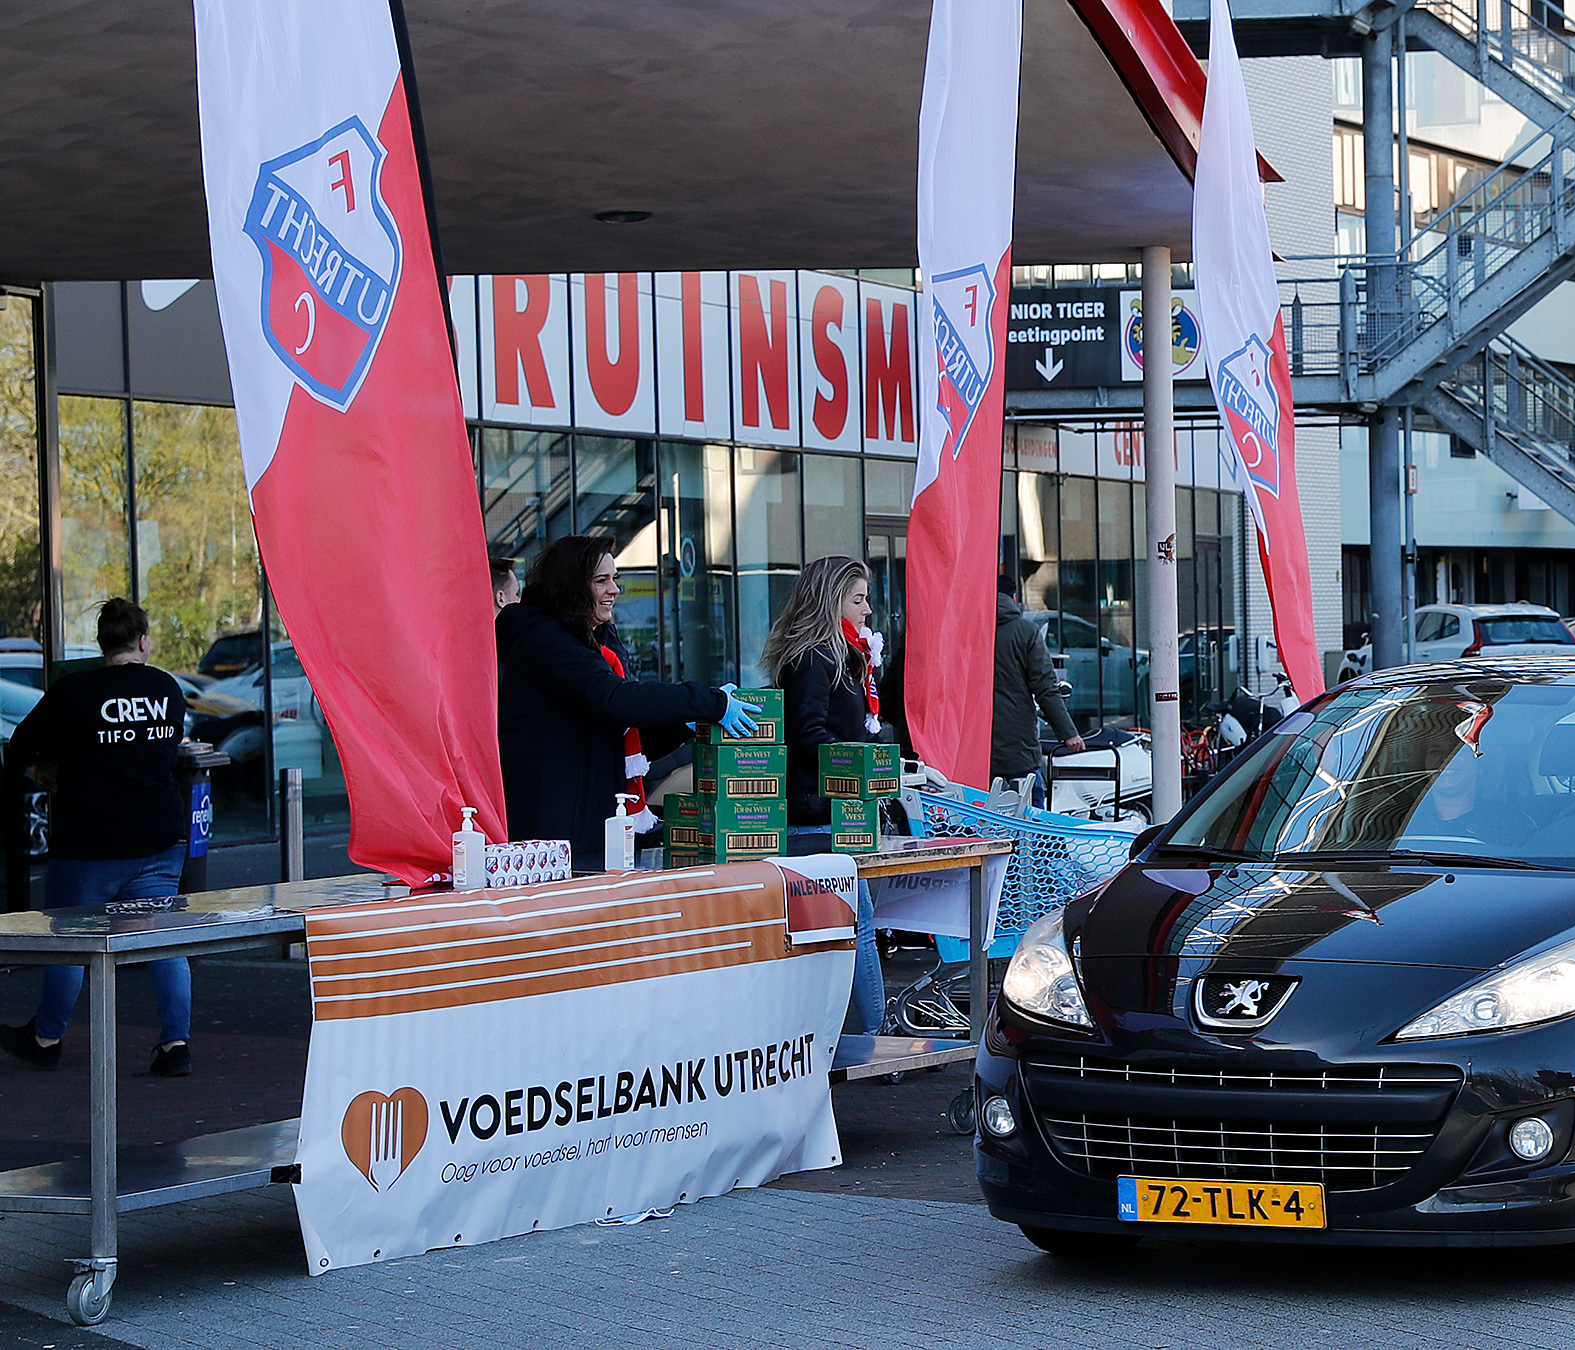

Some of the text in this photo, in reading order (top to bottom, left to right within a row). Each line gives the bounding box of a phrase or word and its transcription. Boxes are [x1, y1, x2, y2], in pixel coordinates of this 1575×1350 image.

[1010, 301, 1106, 320] NIOR TIGER
[1008, 325, 1105, 346] eetingpoint
[447, 271, 915, 442] RUINSM
[100, 696, 169, 723] CREW
[97, 726, 175, 744] TIFO ZUID
[789, 876, 855, 898] INLEVERPUNT
[439, 1032, 815, 1145] VOEDSELBANK UTRECHT
[441, 1161, 479, 1184] Oog
[481, 1158, 522, 1175] voor
[524, 1140, 582, 1170] voedsel,
[614, 1131, 649, 1150] voor
[650, 1120, 709, 1144] mensen
[1120, 1203, 1136, 1214] NL
[1147, 1184, 1305, 1222] 72-TLK-4
